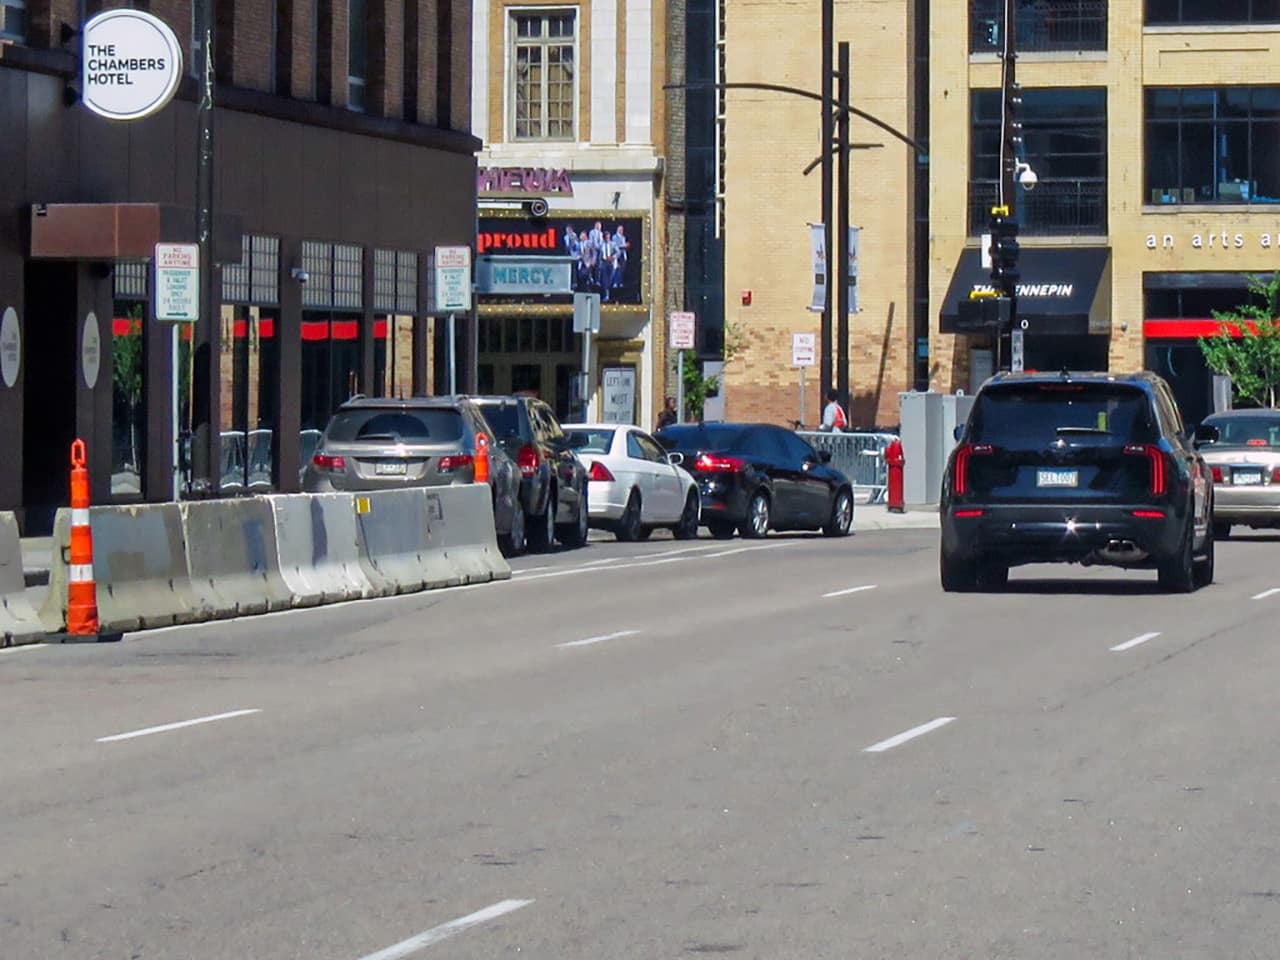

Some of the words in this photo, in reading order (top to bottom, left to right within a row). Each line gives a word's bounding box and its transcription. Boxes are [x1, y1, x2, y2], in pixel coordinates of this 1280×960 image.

[88, 44, 116, 56] THE
[88, 58, 166, 71] CHAMBERS
[88, 73, 133, 85] HOTEL
[477, 227, 557, 253] proud
[1146, 233, 1174, 248] an
[1191, 230, 1244, 248] arts
